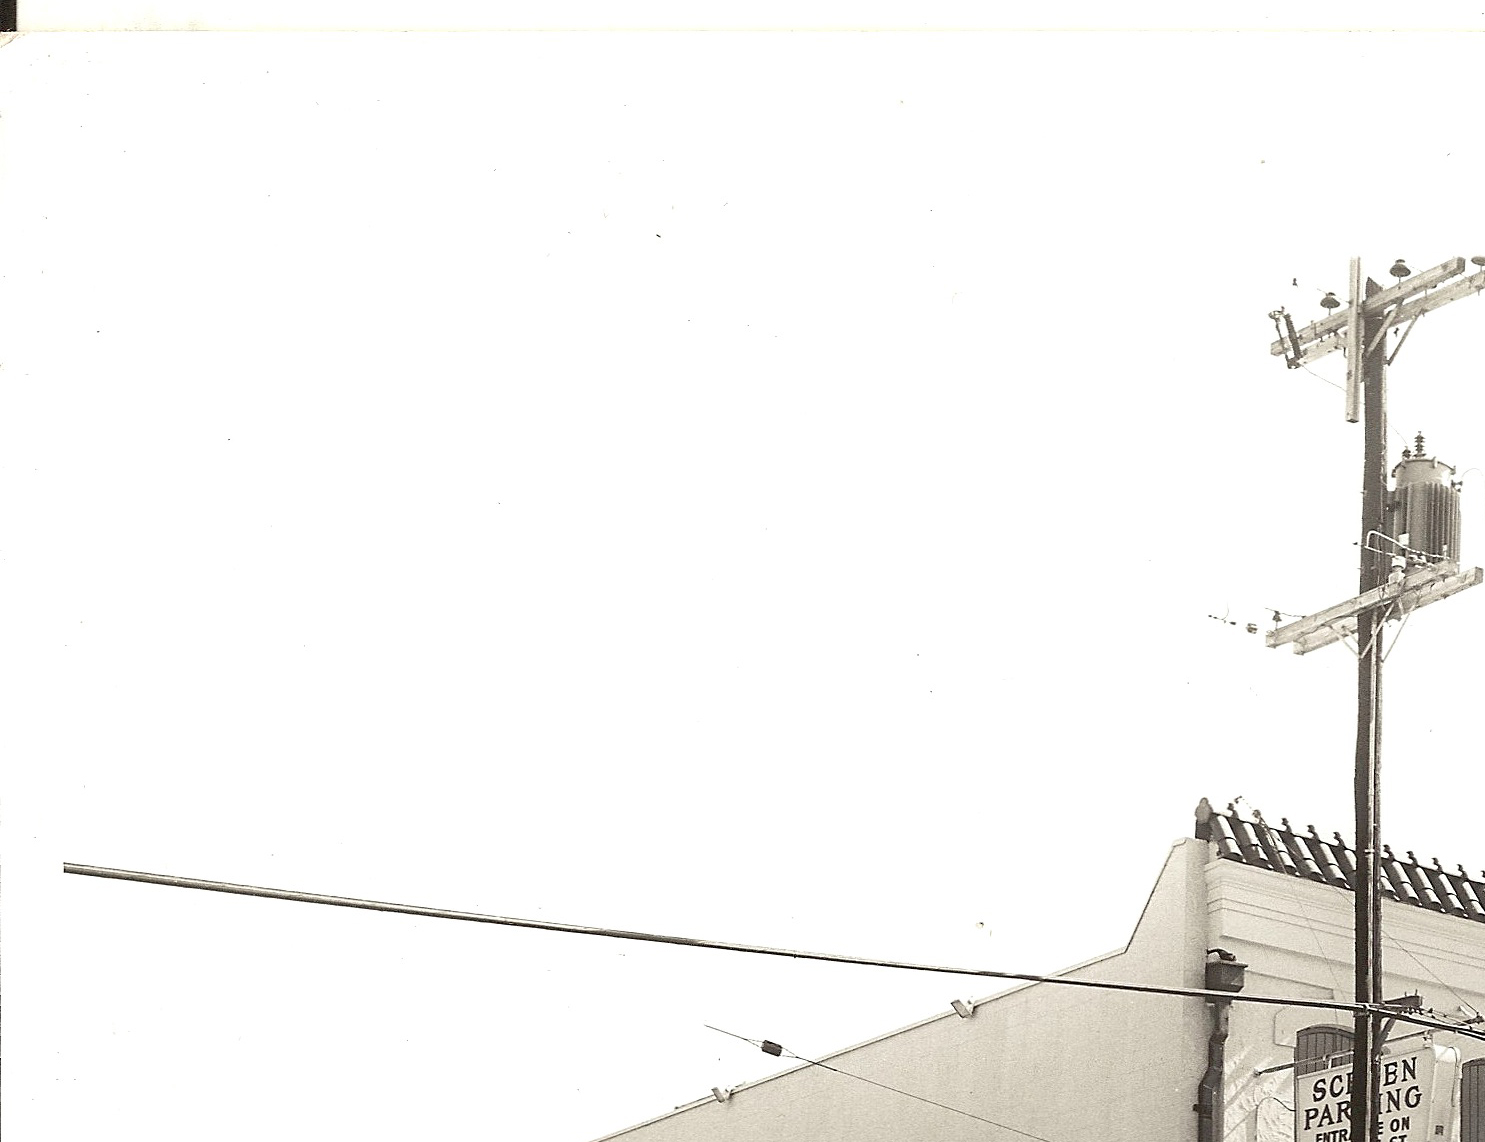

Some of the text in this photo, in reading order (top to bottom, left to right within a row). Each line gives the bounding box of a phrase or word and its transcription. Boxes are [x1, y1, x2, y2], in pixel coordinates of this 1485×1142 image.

[1312, 1057, 1417, 1103] SCEN
[1303, 1085, 1423, 1131] PARING
[1390, 1116, 1410, 1133] ON
